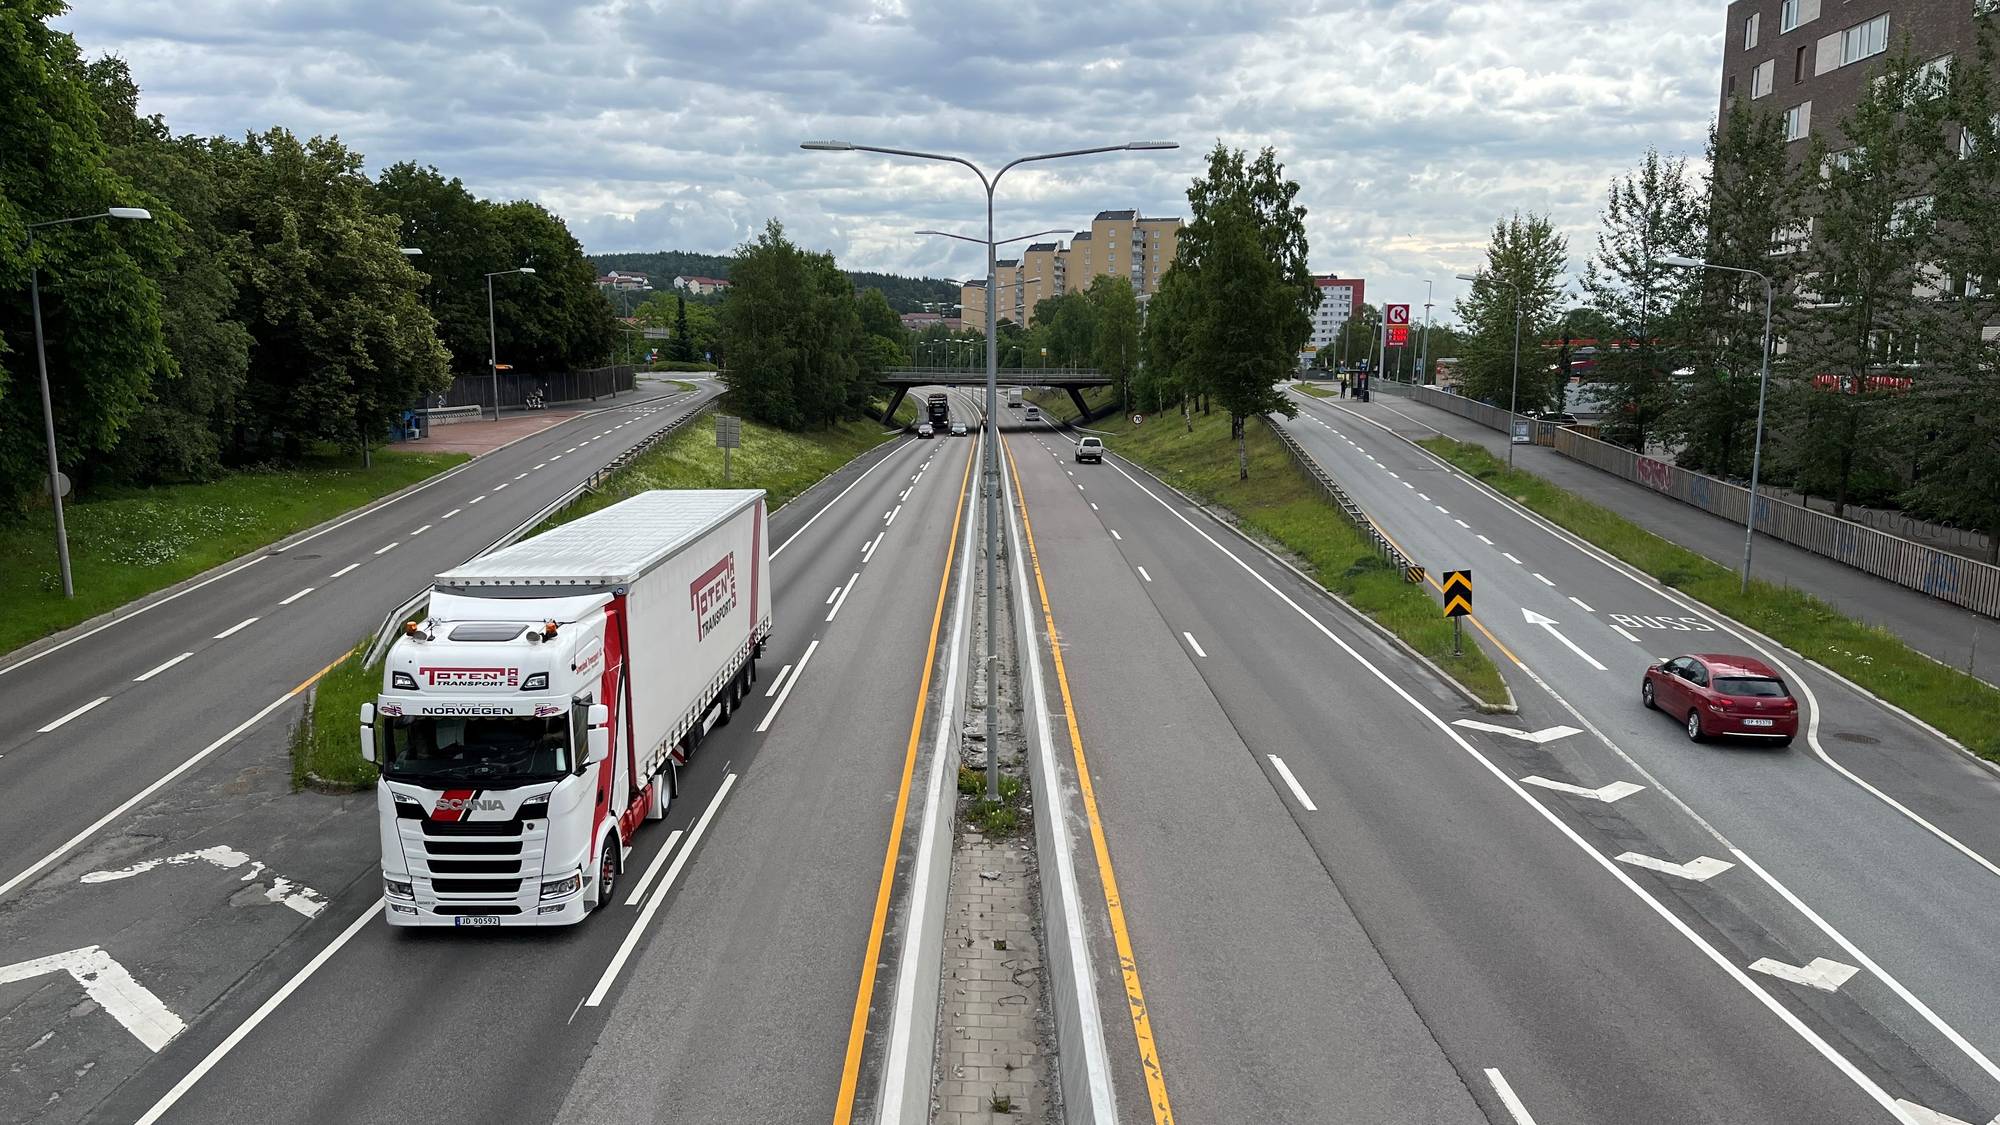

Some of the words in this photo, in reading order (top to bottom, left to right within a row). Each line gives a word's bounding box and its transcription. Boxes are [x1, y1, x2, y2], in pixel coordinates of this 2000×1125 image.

[690, 554, 729, 642] TOTEN
[702, 597, 732, 639] TRANSPORT
[1608, 613, 1716, 631] BUSS
[419, 667, 506, 686] TOTEN
[422, 707, 514, 715] NORWEGEN
[436, 799, 505, 811] SCANIA
